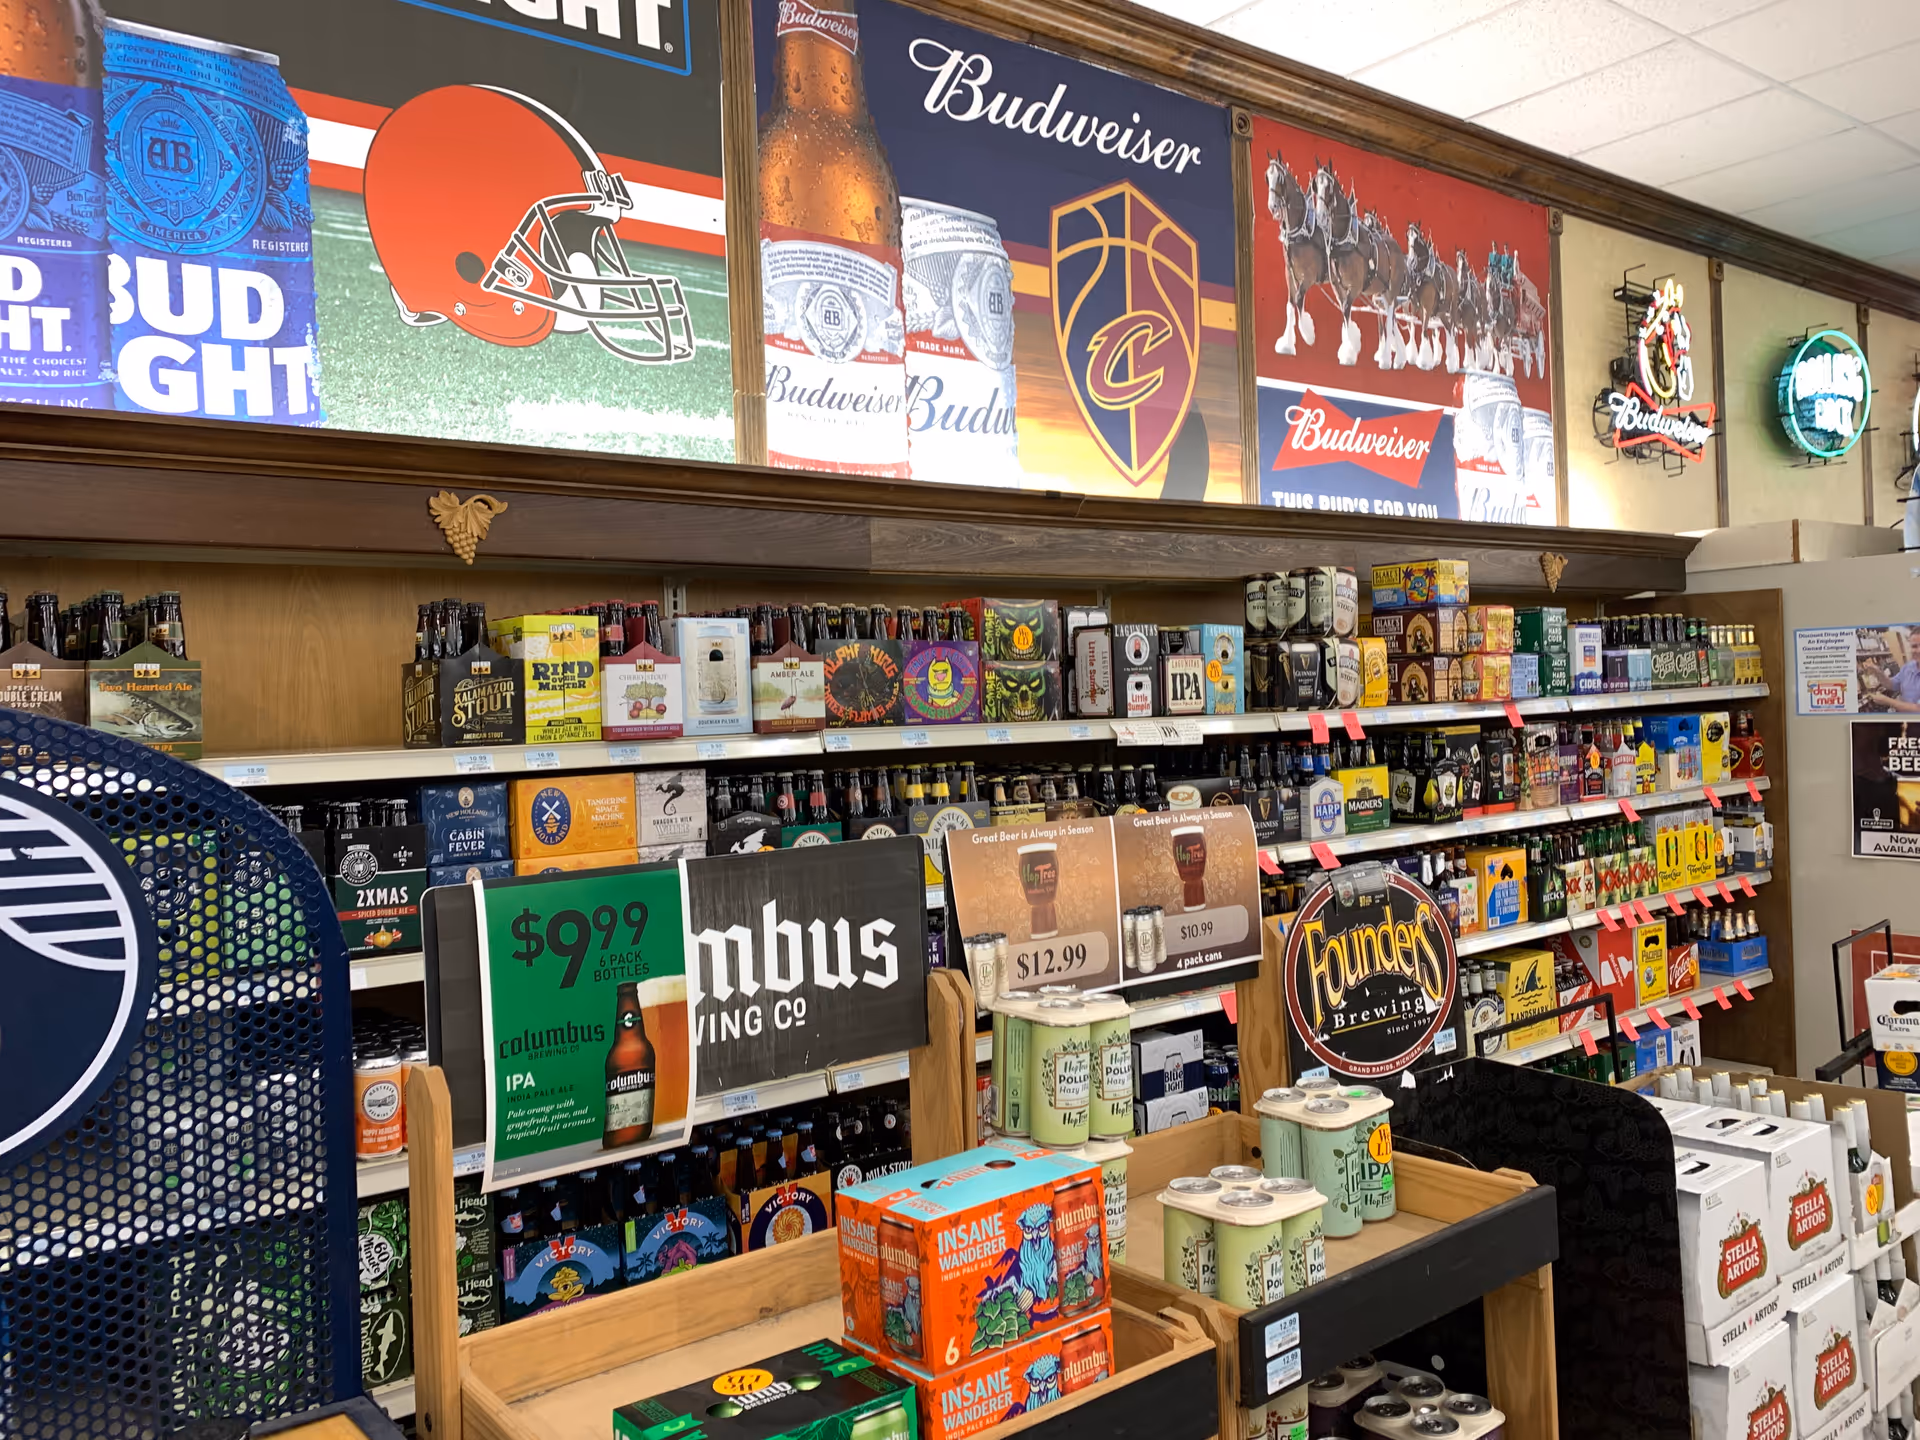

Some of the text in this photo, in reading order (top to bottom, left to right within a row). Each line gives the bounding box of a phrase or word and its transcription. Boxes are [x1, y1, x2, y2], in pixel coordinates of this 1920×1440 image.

[779, 0, 859, 42] Budweiser
[909, 37, 1201, 174] Budweiser
[216, 189, 238, 216] ASIA
[17, 236, 73, 248] REGISTERED
[145, 224, 202, 241] AMERICA
[252, 239, 309, 253] REGISTERED
[108, 253, 285, 341] BUD
[916, 340, 966, 357] TRADE MARK
[33, 357, 87, 366] CHOICEST
[766, 361, 905, 414] Budweiser
[1608, 391, 1713, 444] Budweiser
[1285, 405, 1430, 460] Budweiser
[1546, 614, 1563, 623] JACK'S
[984, 607, 996, 657] ZOMBIE
[1114, 624, 1158, 638] LAGUNITAS
[1547, 634, 1563, 643] CIDER
[1548, 627, 1562, 637] HARD
[532, 661, 594, 681] RIND
[1171, 659, 1200, 669] LAGUNITAS
[1551, 658, 1566, 668] JACK'S
[770, 670, 815, 679] AMBER ALE
[1579, 678, 1602, 689] CIDER
[99, 682, 193, 692] Two Hearted Ale
[453, 680, 515, 703] KALAMAZOO
[538, 681, 587, 691] MATTER
[984, 669, 996, 719] ZOMBIE
[1171, 672, 1202, 701] IPA
[1813, 685, 1838, 698] drug
[1131, 693, 1149, 703] Little
[1817, 697, 1841, 706] mart
[452, 691, 515, 728] STOUT
[541, 788, 562, 800] NEW
[586, 796, 629, 807] TANGERINE
[595, 805, 620, 814] SPACE
[1315, 804, 1341, 817] HARP
[1348, 799, 1383, 812] MAGNERS
[590, 812, 625, 822] MACHINE
[652, 816, 693, 826] DRAGON'S MILK
[933, 812, 969, 833] KENTUCKY
[1133, 815, 1155, 828] Great
[1155, 814, 1172, 826] Beer
[1179, 812, 1203, 826] Always
[1209, 809, 1234, 821] Season
[449, 828, 486, 841] CABIN
[534, 824, 570, 846] HOLLAND
[972, 824, 1094, 845] Great Beer is Always in Season
[448, 840, 486, 852] FEVER
[356, 886, 409, 908] 2XMAS
[1542, 890, 1566, 903] BECK'S
[358, 906, 408, 919] SPICED DOUBLE ALE
[1179, 920, 1214, 941] $10.99
[598, 949, 643, 967] 6 PACK
[1016, 943, 1088, 981] $12.99
[1176, 951, 1223, 970] 4 pack cans
[1302, 900, 1443, 1034] Founders
[593, 963, 650, 983] BOTTLES
[1333, 995, 1426, 1029] Brewing
[1402, 1012, 1416, 1021] Co.
[1876, 1013, 1920, 1027] Corona
[1386, 1017, 1432, 1036] Since 1997
[1889, 1023, 1910, 1033] Extra
[1348, 1046, 1423, 1074] GRAND RAPIDS, MICHIGAN
[505, 1071, 536, 1093] IPA
[1164, 1071, 1184, 1083] Blue
[1164, 1080, 1184, 1093] LIGHT
[1059, 1084, 1080, 1095] Hazy
[505, 1105, 589, 1133] grapefruit, pine, and
[507, 1098, 575, 1120] Pale orange with
[865, 1166, 887, 1182] MILK
[1360, 1162, 1391, 1181] IPA
[460, 1195, 487, 1214] Head
[765, 1191, 814, 1214] VICTORY
[1793, 1192, 1825, 1221] STELLA
[653, 1216, 705, 1240] VICTORY
[840, 1215, 877, 1244] INSANE
[1796, 1207, 1826, 1236] ARTOIS
[937, 1211, 1006, 1256] INSANE
[363, 1235, 382, 1274] Minute
[373, 1241, 390, 1262] 60
[841, 1234, 878, 1258] WANDERER
[938, 1236, 1007, 1273] WANDERER
[1725, 1235, 1759, 1266] STELLA
[535, 1243, 595, 1270] VICTORY
[940, 1258, 993, 1283] INDIA PALE ALE
[1727, 1252, 1760, 1283] ARTOIS
[1792, 1251, 1846, 1294] STELLA ARTOIS
[465, 1275, 493, 1295] Head
[1280, 1317, 1297, 1331] 12.99
[1722, 1297, 1779, 1347] STELLA ARTOIS
[944, 1336, 960, 1366] 6
[1282, 1350, 1298, 1364] 12.99
[1820, 1347, 1850, 1378] STELLA
[1822, 1364, 1850, 1395] ARTOIS
[941, 1367, 1012, 1416] INSANE
[942, 1391, 1013, 1432] WANDERER
[1753, 1405, 1784, 1437] STELLA
[945, 1415, 998, 1440] INDIA PALE ALE
